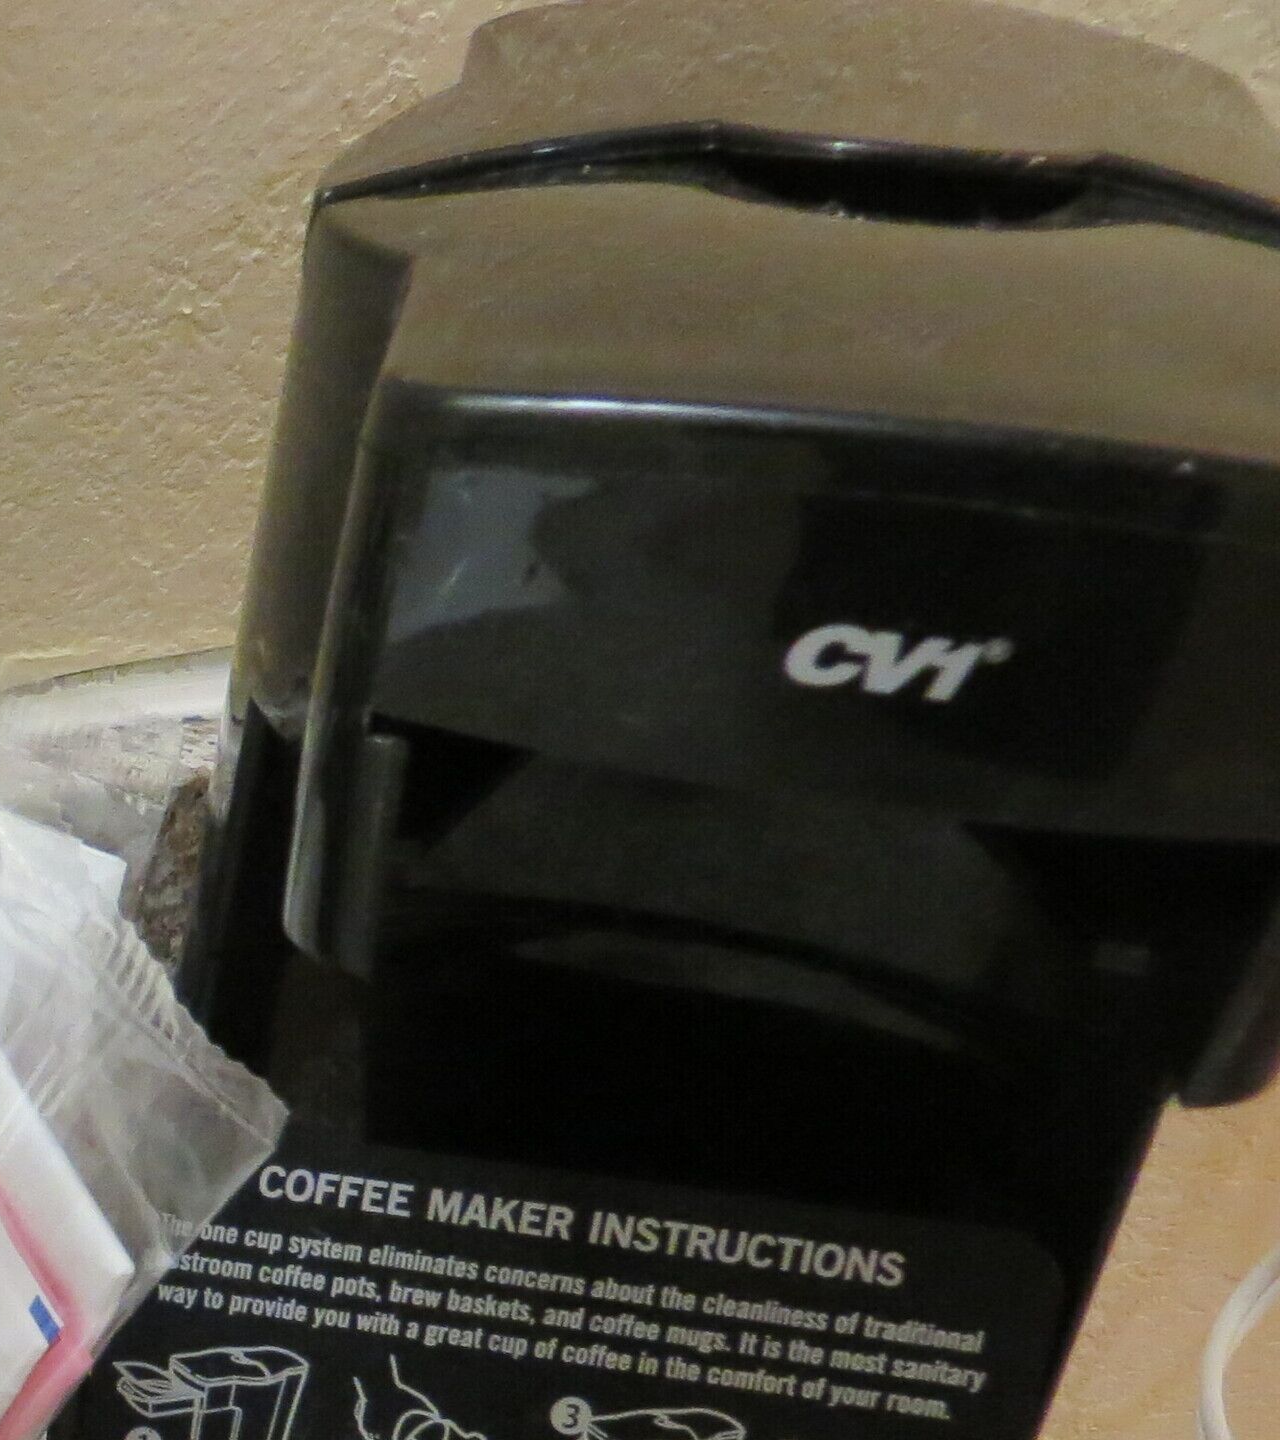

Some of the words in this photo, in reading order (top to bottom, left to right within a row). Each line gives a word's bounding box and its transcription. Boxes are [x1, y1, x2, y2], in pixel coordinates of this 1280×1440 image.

[201, 1223, 239, 1244] one
[244, 1229, 283, 1255] cup
[288, 1235, 363, 1264] system
[368, 1245, 479, 1280] eliminates
[484, 1263, 585, 1296] concerns
[591, 1277, 655, 1307] about
[661, 1285, 697, 1311] the
[702, 1293, 828, 1332] cleanliness
[834, 1311, 860, 1335] of
[863, 1314, 985, 1354] traditional
[259, 1166, 415, 1218] COFFEE
[427, 1189, 575, 1241] MAKER
[589, 1212, 906, 1288] INSTRUCTIONS
[158, 1283, 198, 1309] way
[202, 1287, 224, 1310] to
[228, 1292, 309, 1322] provide
[311, 1307, 351, 1331] you
[356, 1311, 400, 1337] with
[405, 1322, 417, 1340] a
[423, 1322, 484, 1352] great
[488, 1333, 528, 1360] cup
[535, 1337, 559, 1361] of
[560, 1344, 631, 1372] coffee
[637, 1351, 658, 1377] in
[665, 1355, 701, 1383] the
[706, 1362, 797, 1397] comfort
[800, 1375, 826, 1401] of
[828, 1383, 882, 1411] your
[885, 1390, 952, 1421] room.
[258, 1263, 327, 1293] coffee
[331, 1274, 383, 1302] pots,
[390, 1281, 442, 1309] brew
[447, 1288, 536, 1326] baskets,
[543, 1302, 583, 1331] and
[589, 1312, 660, 1343] coffee
[666, 1324, 732, 1354] mugs.
[739, 1332, 757, 1355] It
[762, 1336, 780, 1360] is
[787, 1338, 825, 1366] the
[830, 1347, 887, 1374] most
[892, 1354, 987, 1392] sanitary
[563, 1404, 581, 1428] 3
